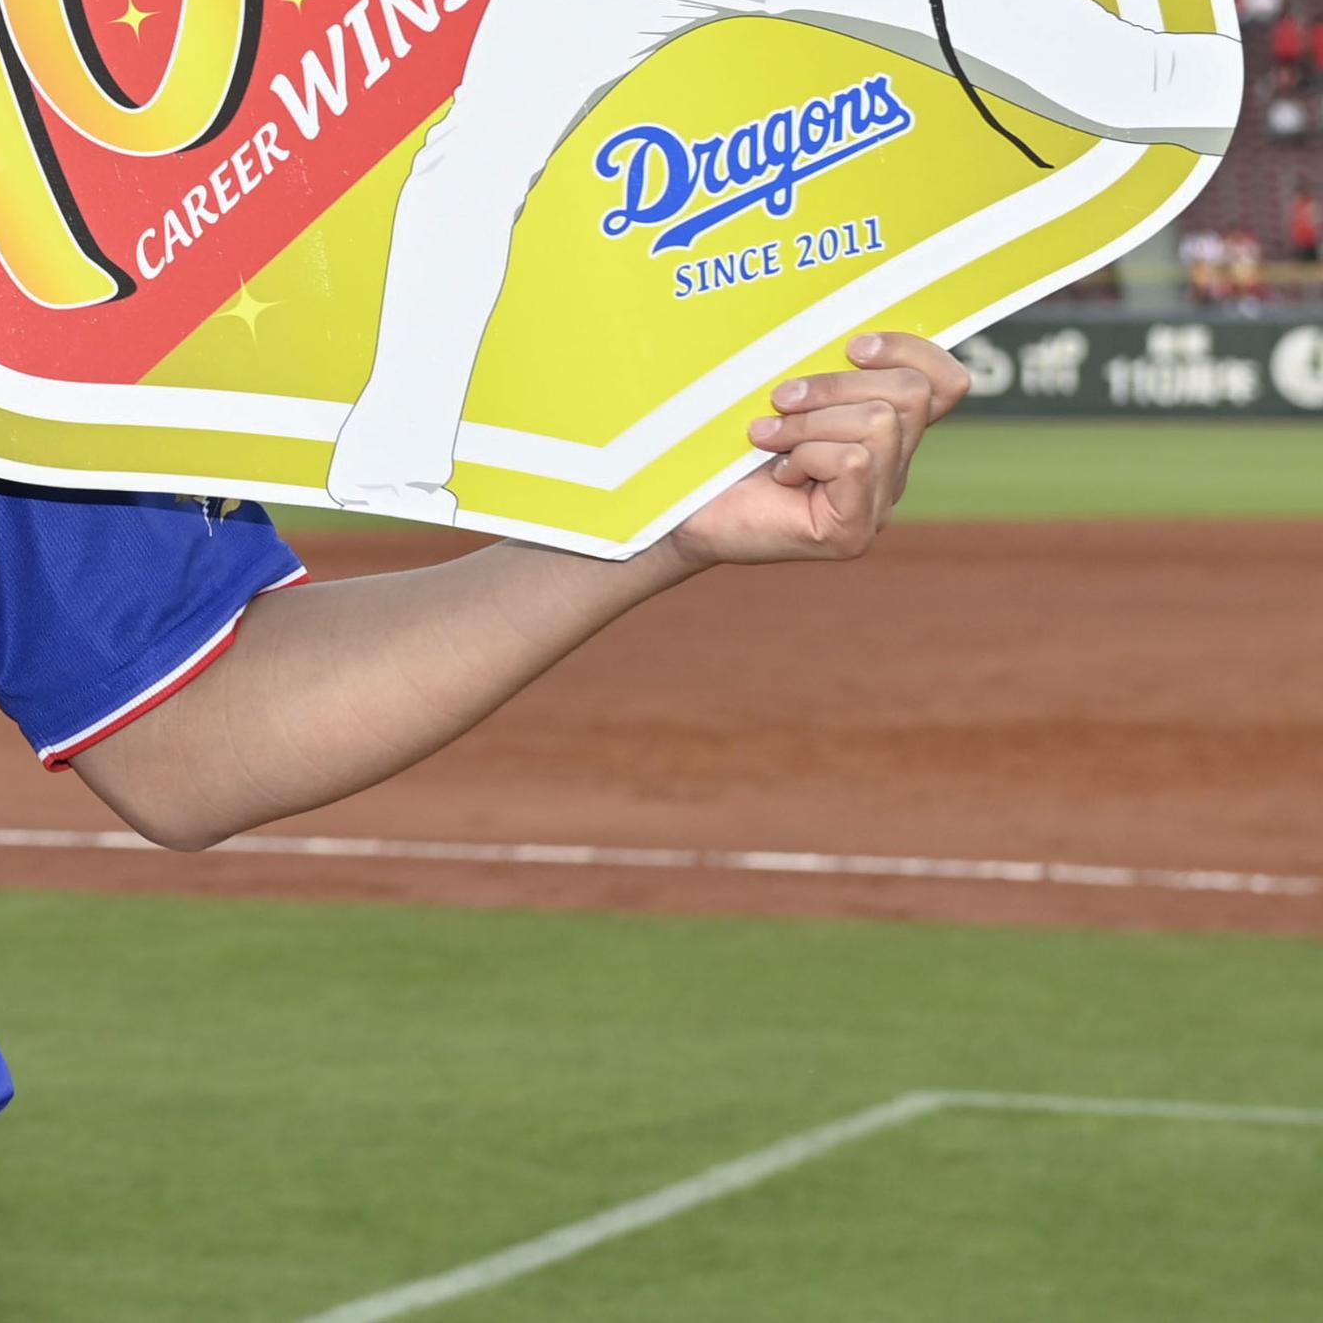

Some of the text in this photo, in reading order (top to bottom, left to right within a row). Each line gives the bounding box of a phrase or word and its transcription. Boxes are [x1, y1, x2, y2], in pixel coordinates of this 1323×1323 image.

[135, 121, 290, 279] CAREER
[596, 76, 911, 253] Dragons
[675, 218, 883, 297] SINCE 2011
[1105, 356, 1262, 405] 110周年
